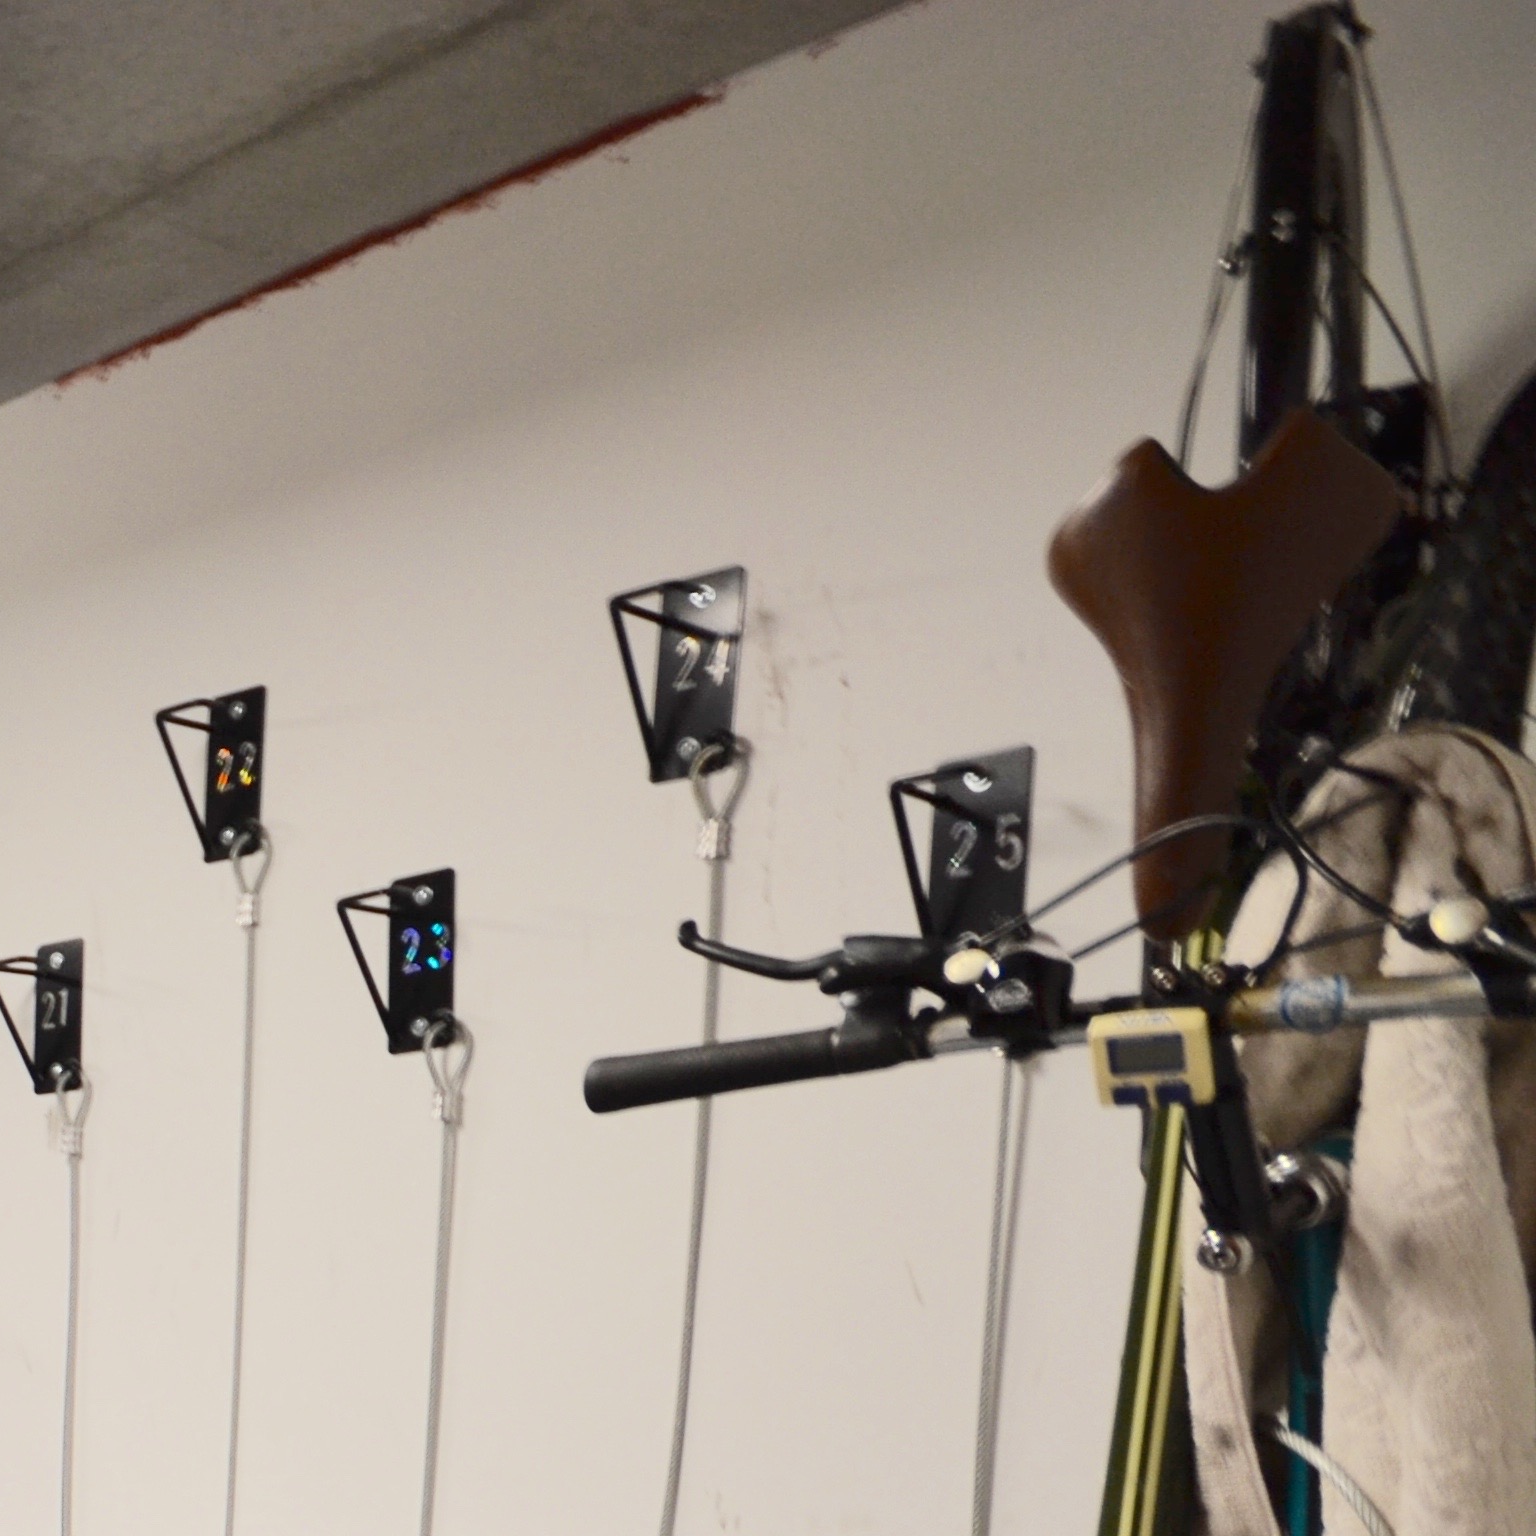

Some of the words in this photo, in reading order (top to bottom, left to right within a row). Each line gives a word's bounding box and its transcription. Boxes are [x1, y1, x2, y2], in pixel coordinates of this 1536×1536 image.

[672, 635, 731, 692] 24
[215, 741, 257, 792] 22
[949, 812, 1023, 878] 25
[400, 922, 452, 974] 23
[41, 988, 68, 1030] 21
